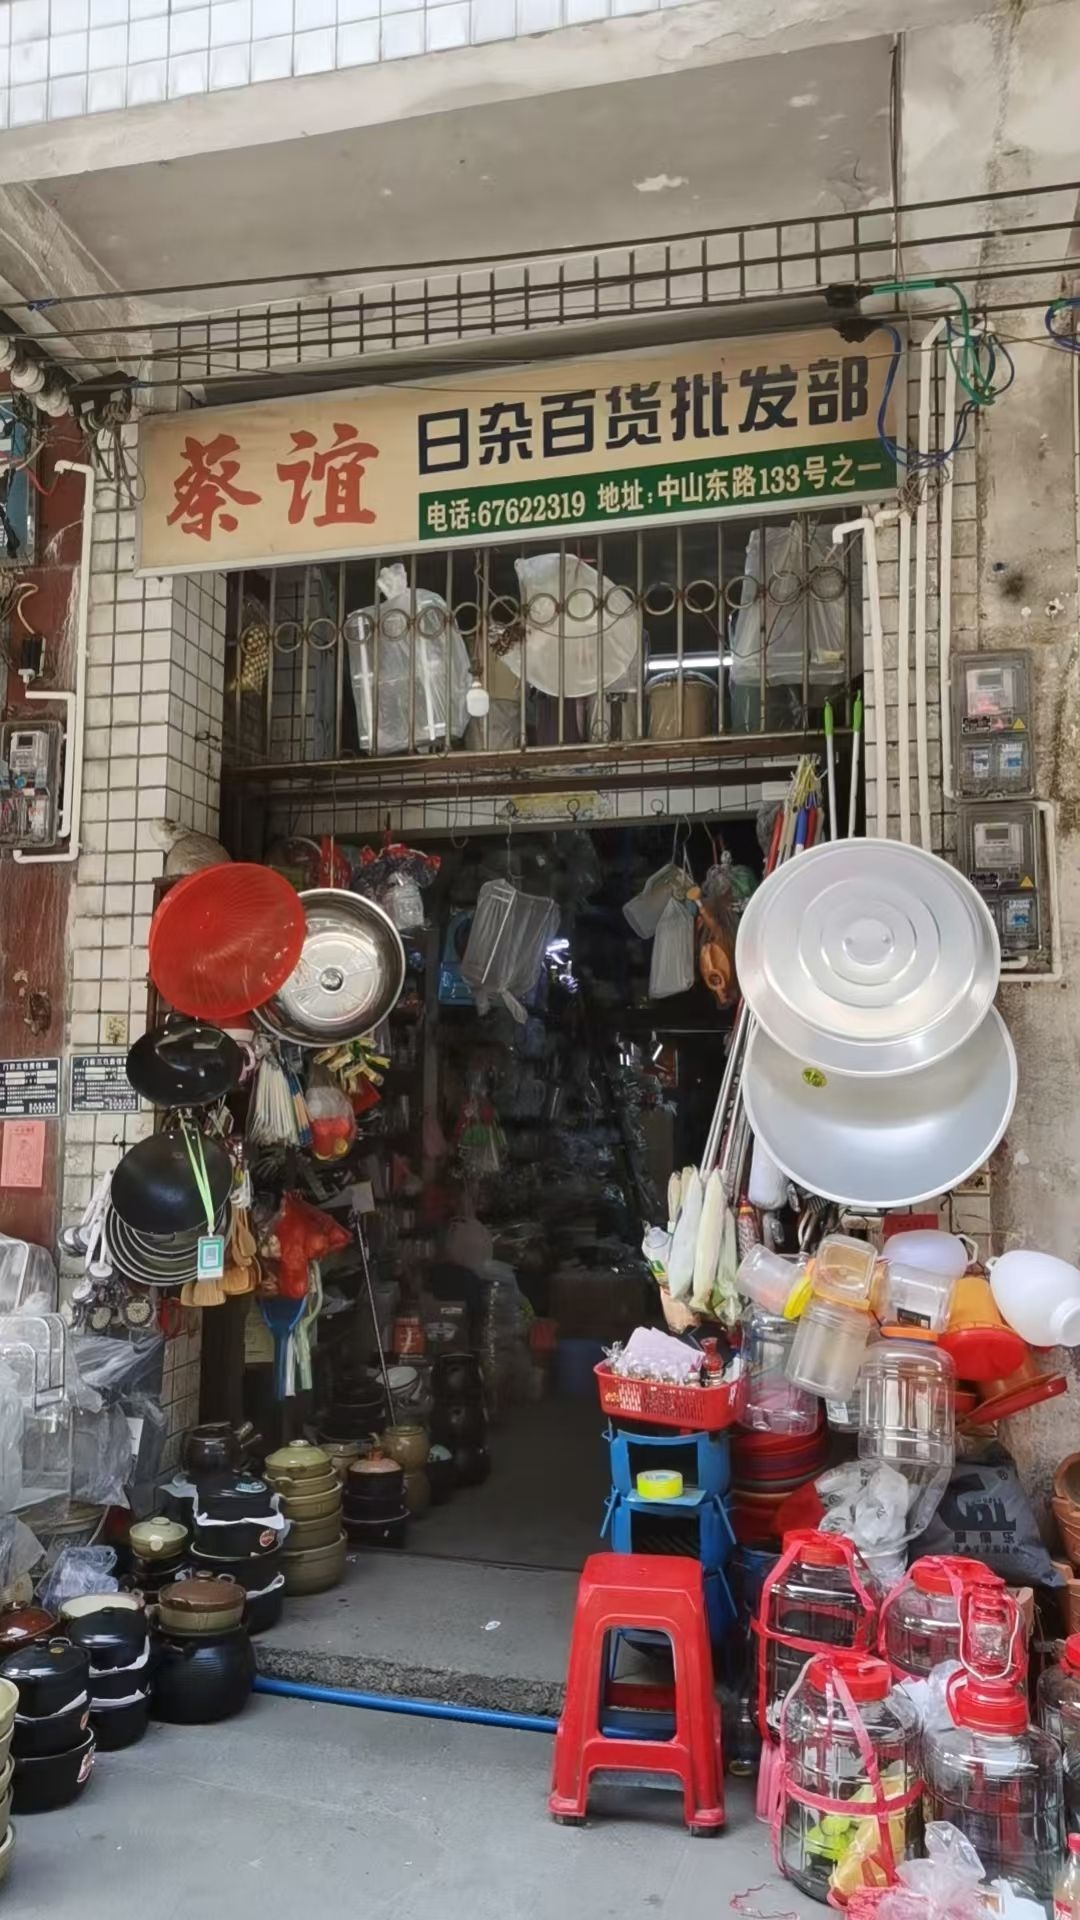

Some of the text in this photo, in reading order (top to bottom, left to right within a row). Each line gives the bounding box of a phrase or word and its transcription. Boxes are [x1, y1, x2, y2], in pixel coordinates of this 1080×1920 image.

[418, 356, 868, 475] 日杂百货批发部
[166, 423, 379, 541] 蔡谊
